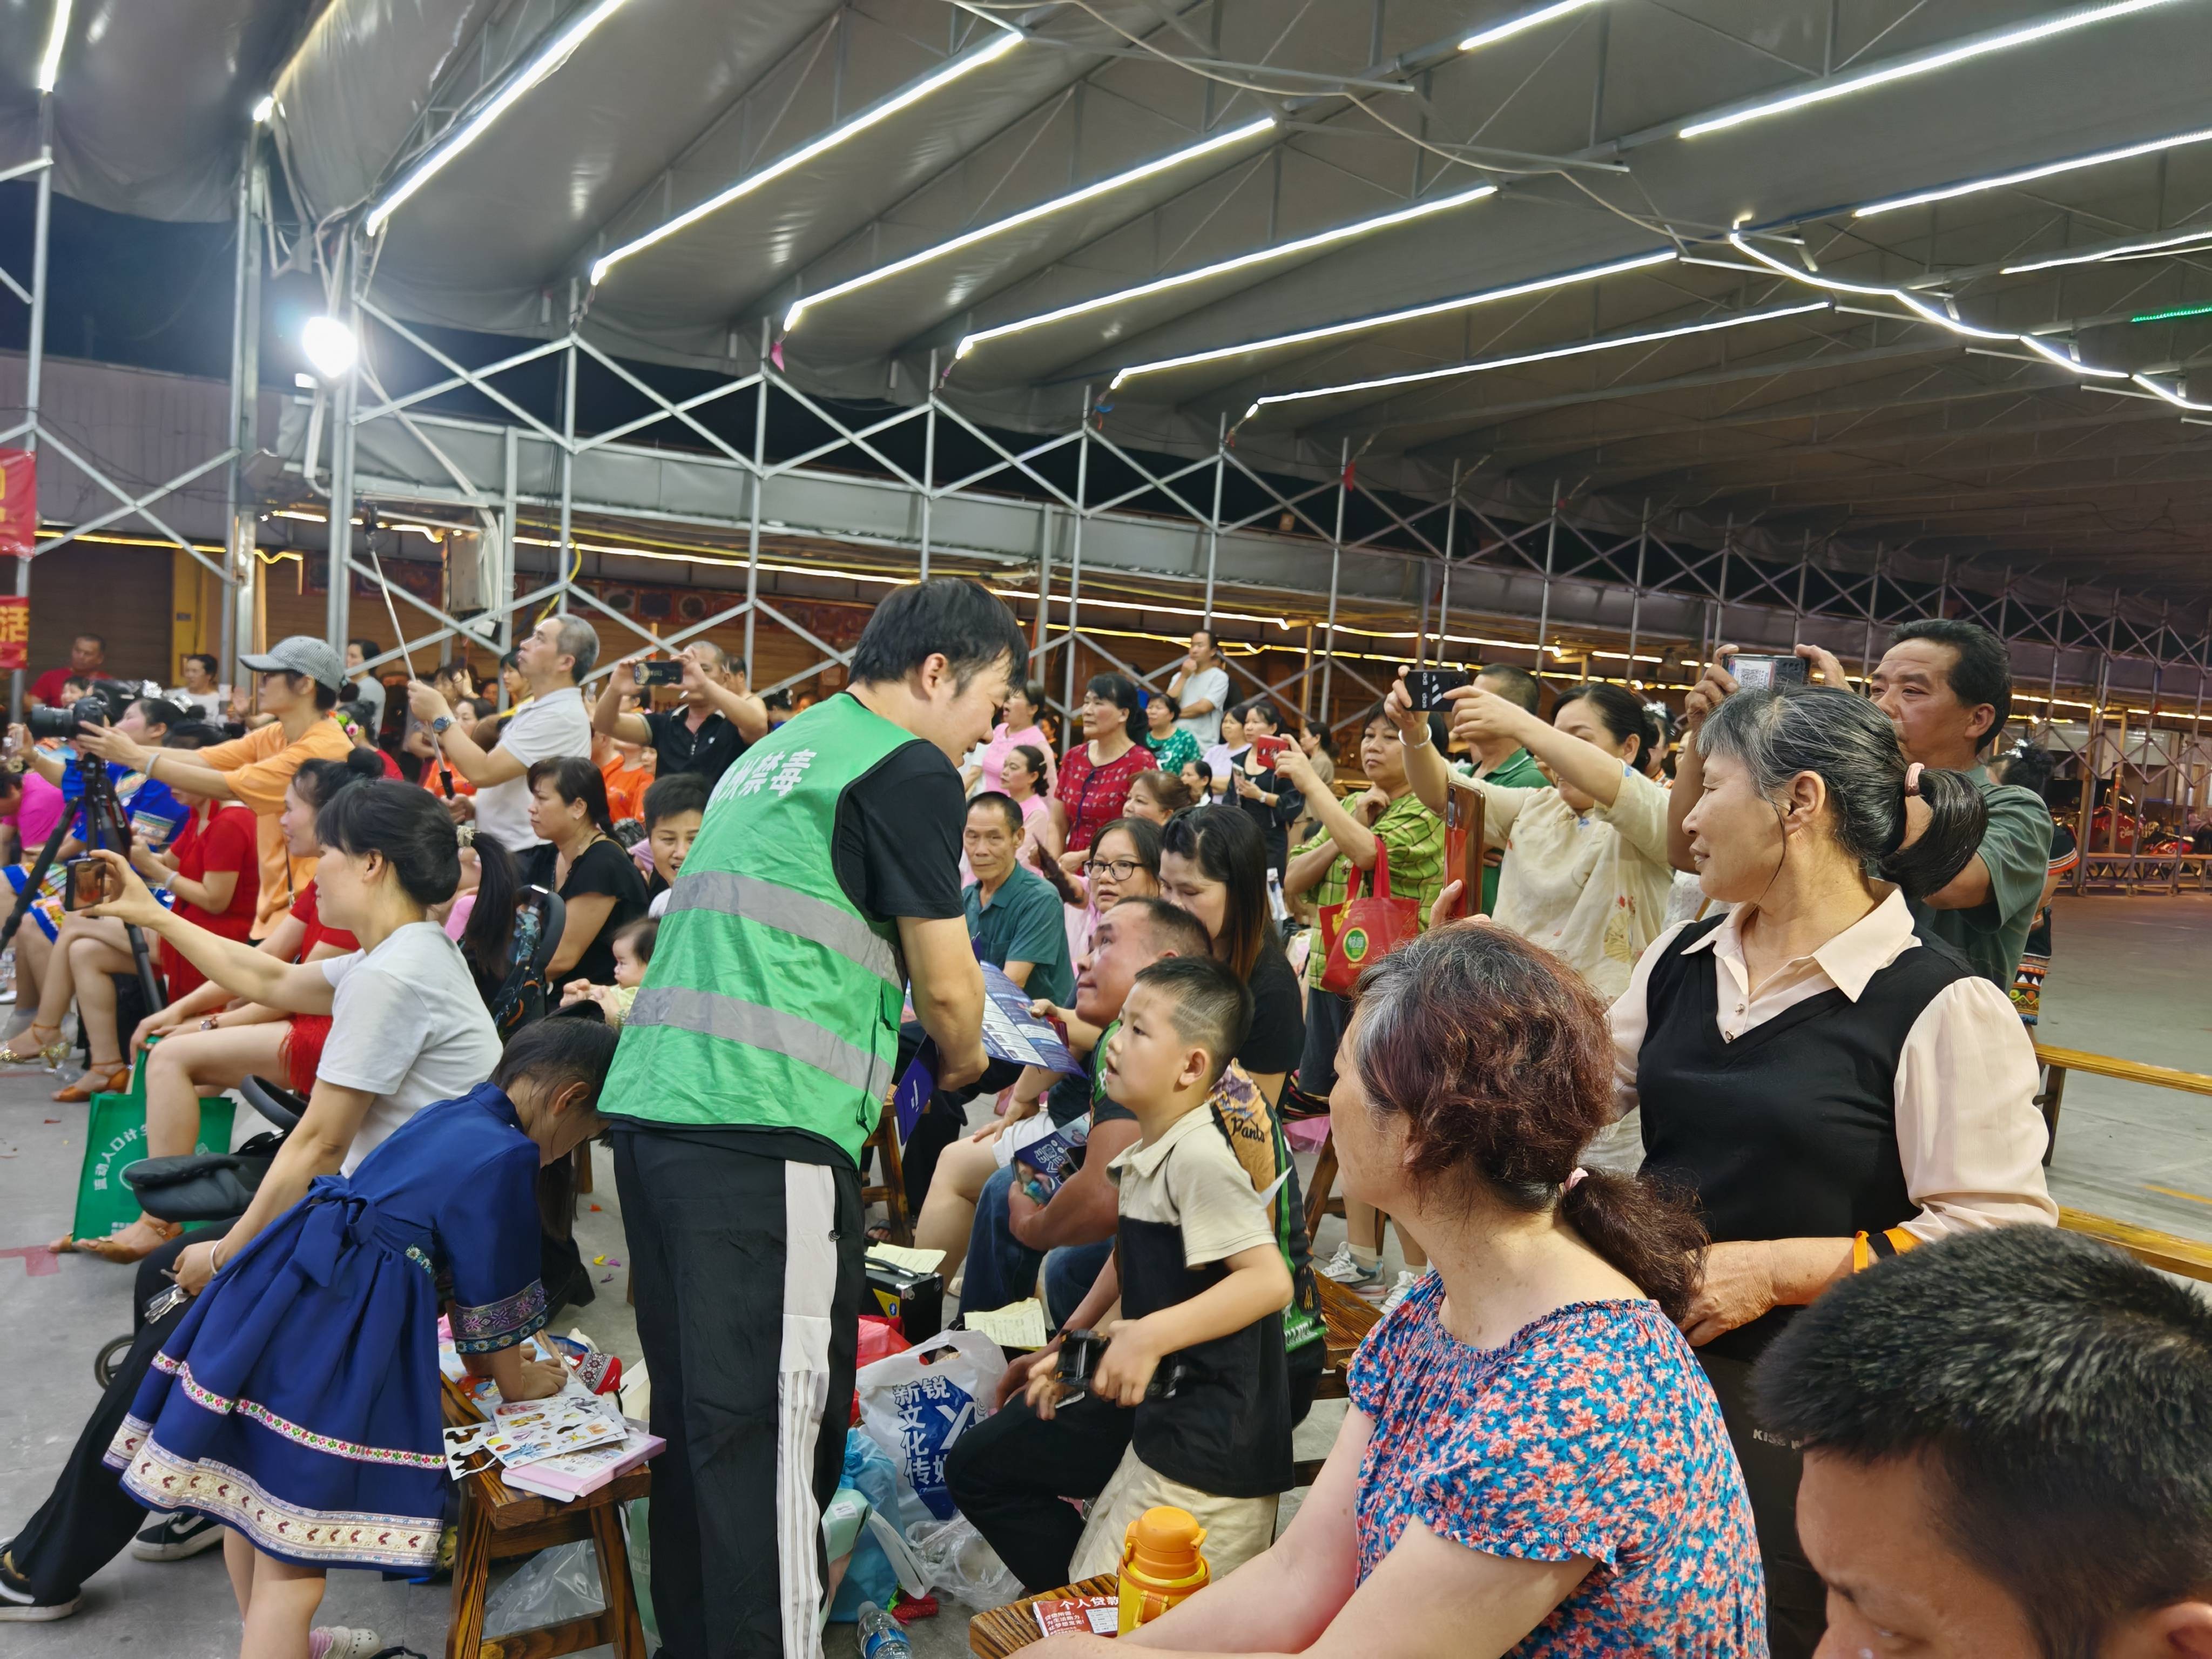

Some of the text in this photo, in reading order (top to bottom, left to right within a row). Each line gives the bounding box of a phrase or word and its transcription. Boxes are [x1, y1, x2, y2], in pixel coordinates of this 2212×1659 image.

[893, 1375, 950, 1405] 新锐
[898, 1404, 927, 1432] 文
[900, 1430, 929, 1459] 化
